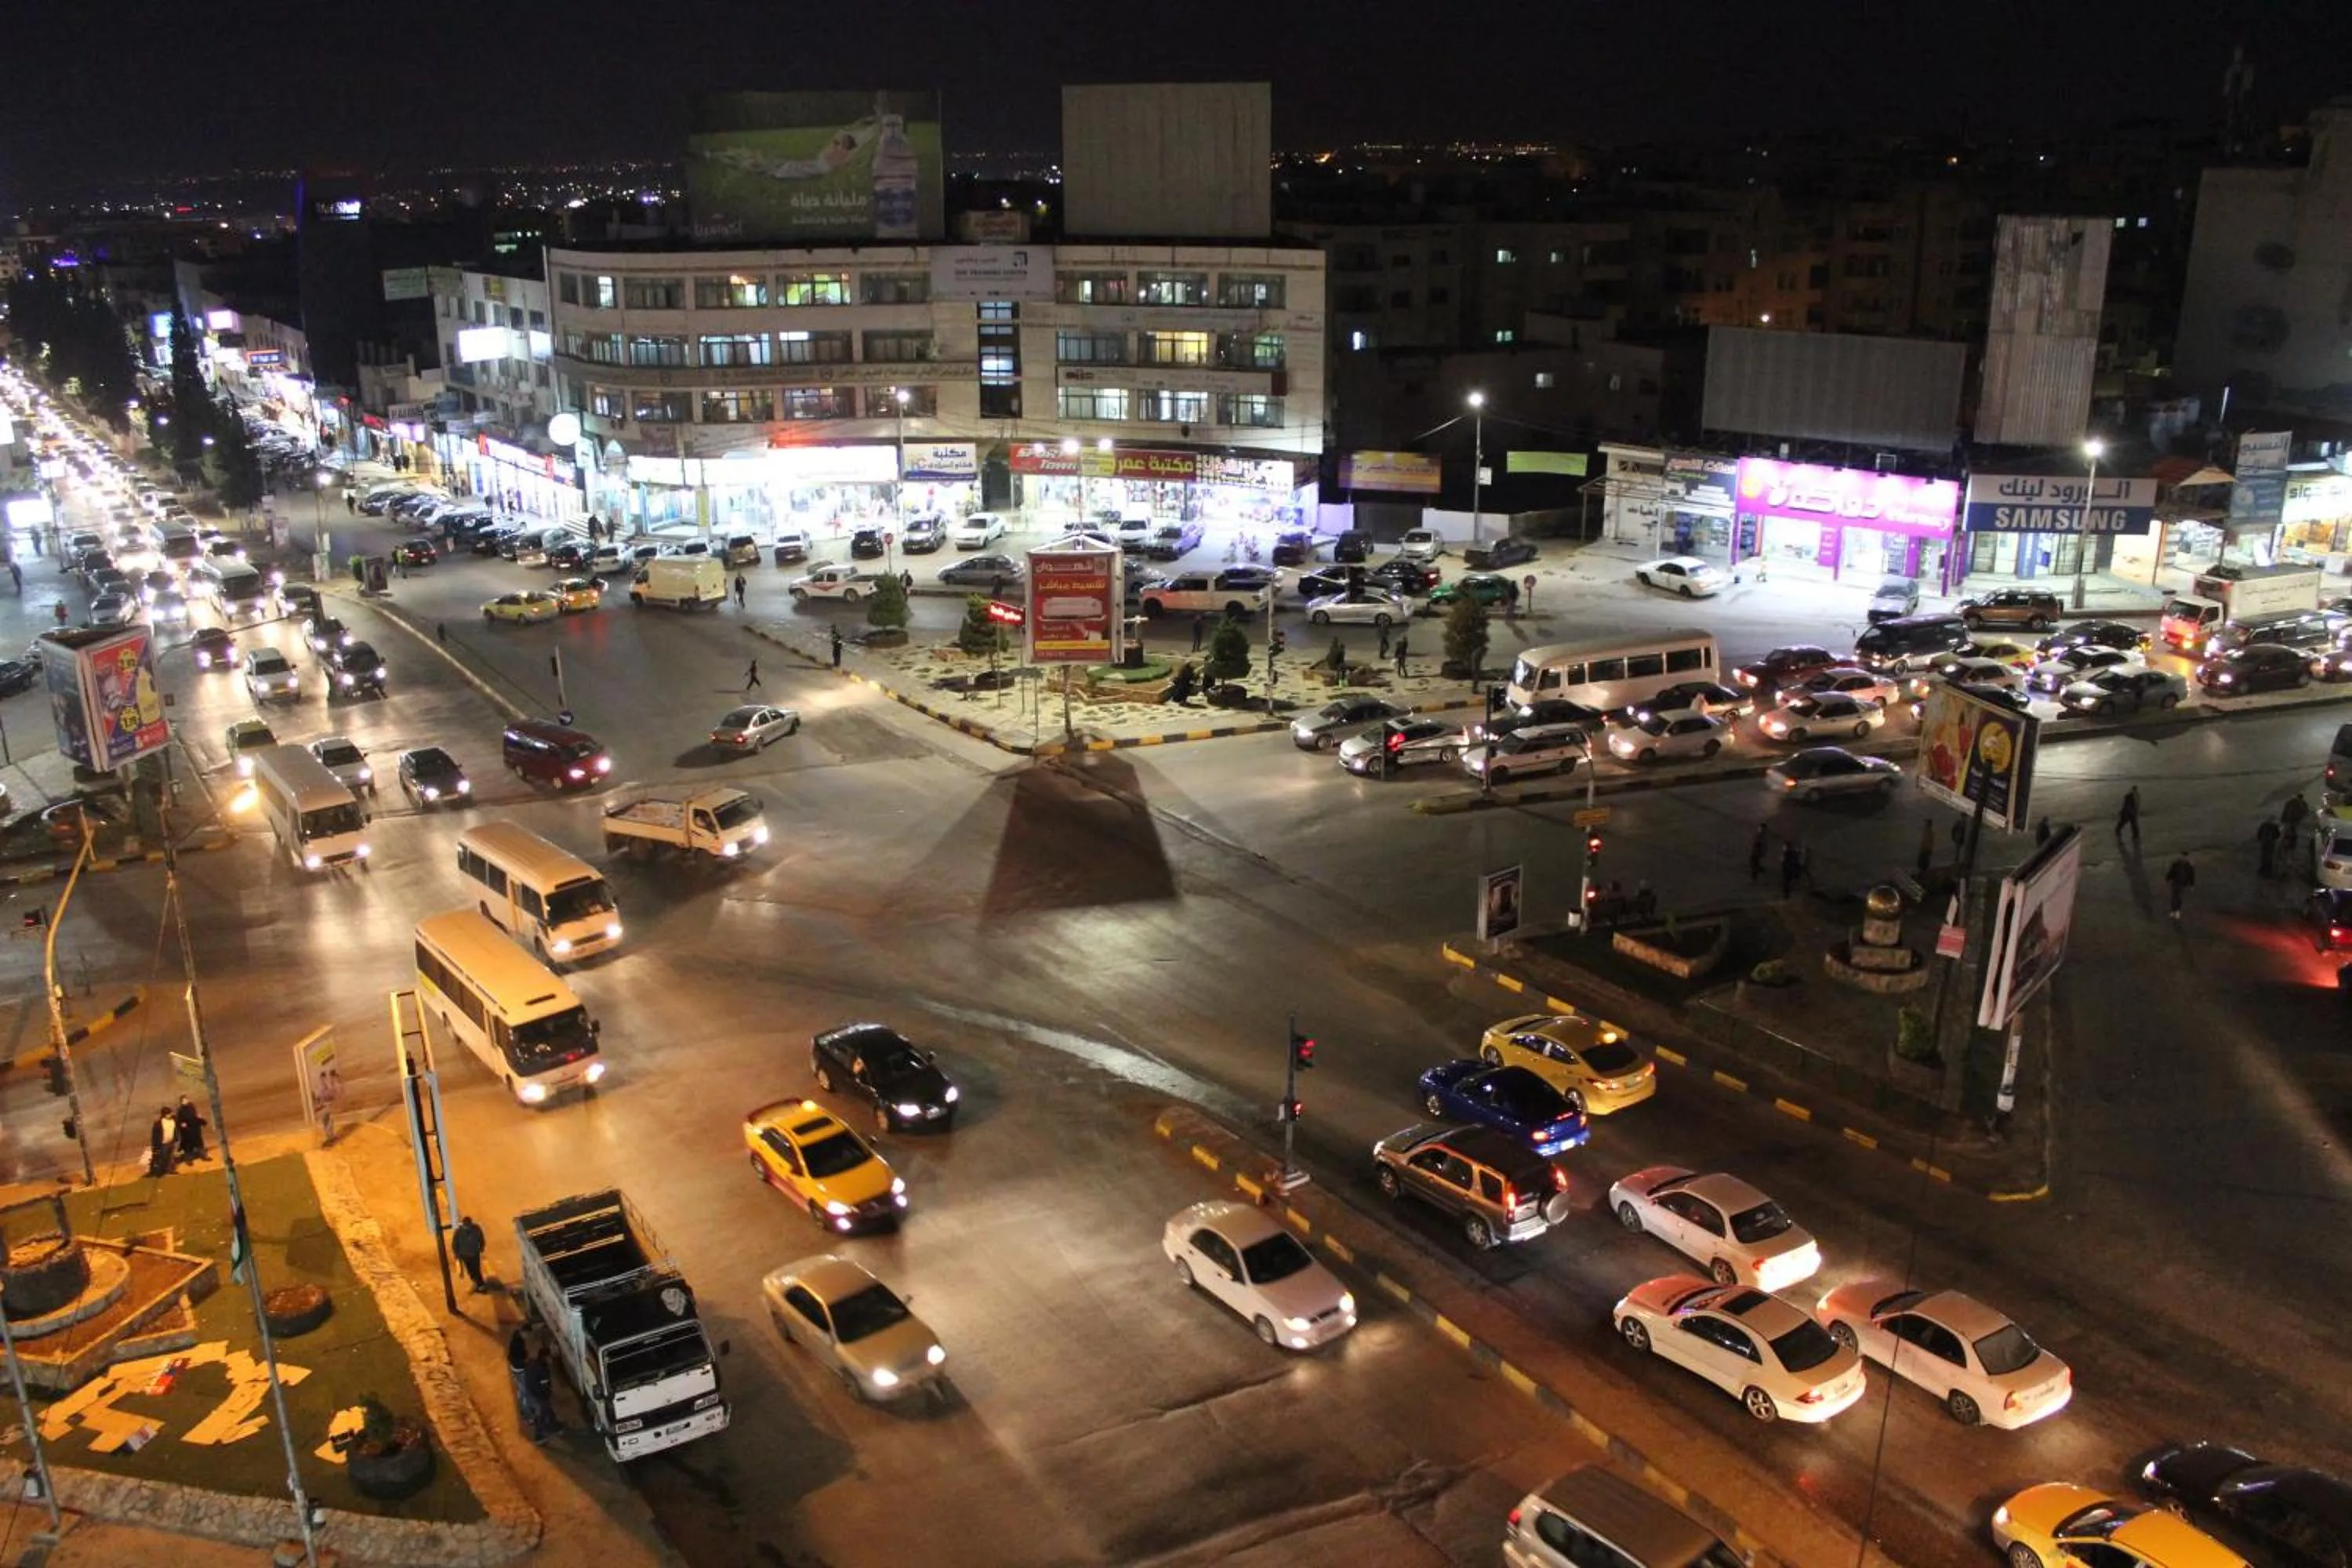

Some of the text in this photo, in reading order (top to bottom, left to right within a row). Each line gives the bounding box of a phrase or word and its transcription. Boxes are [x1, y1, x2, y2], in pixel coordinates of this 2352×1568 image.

[1116, 457, 1146, 474] عمر
[1148, 455, 1195, 474] مكتبة
[1999, 477, 2044, 500] لينك
[1994, 506, 2127, 531] SAMSUNG
